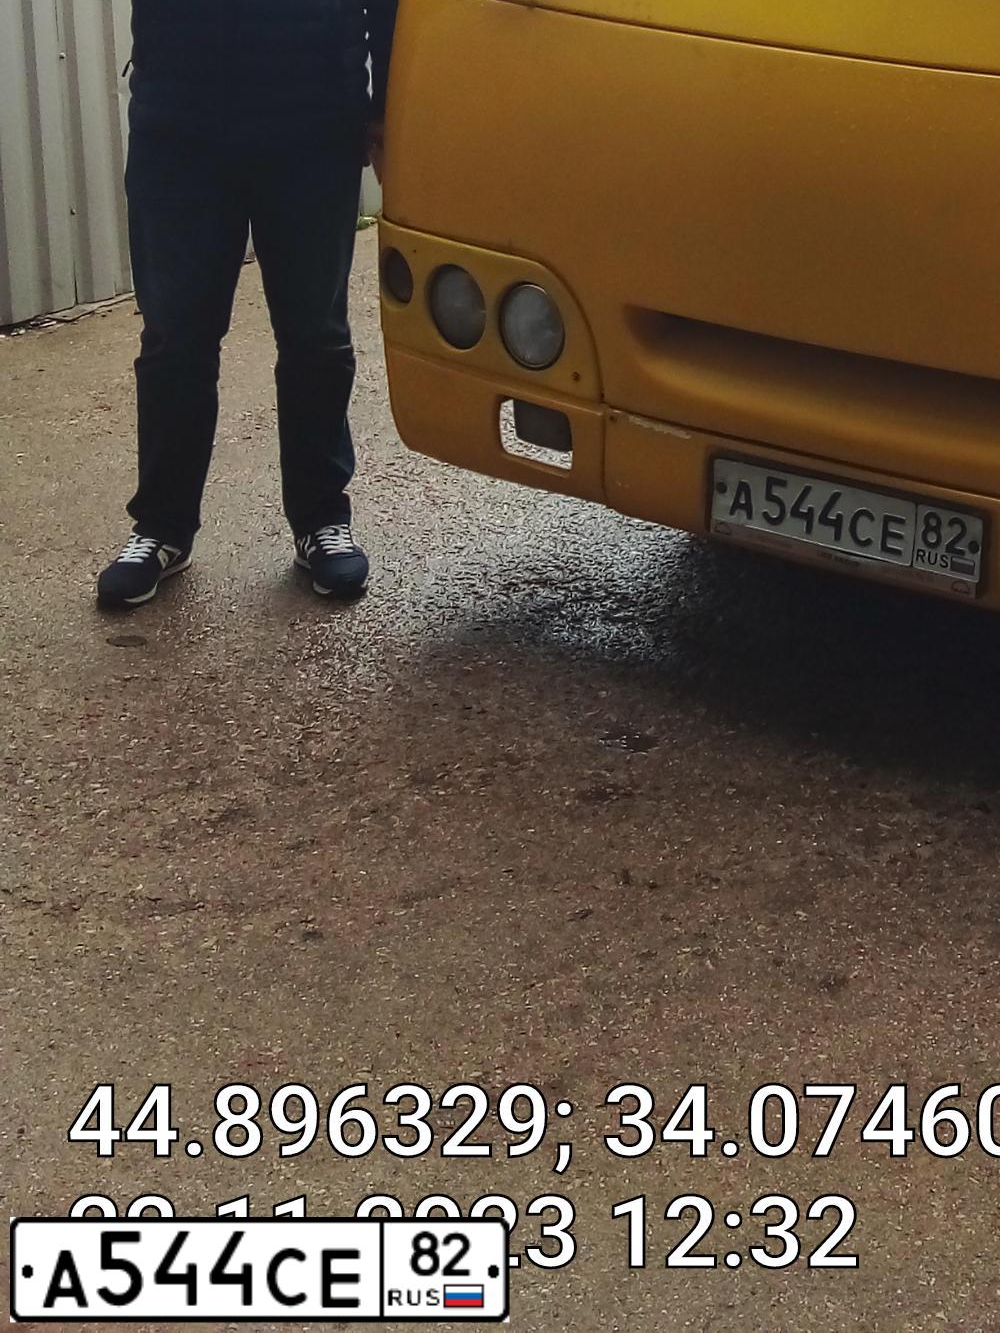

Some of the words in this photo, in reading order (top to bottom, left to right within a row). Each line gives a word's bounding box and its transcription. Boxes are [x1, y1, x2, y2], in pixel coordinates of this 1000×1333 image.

[728, 475, 907, 557] А544СЕ
[920, 510, 969, 557] 82
[915, 548, 950, 569] RUS
